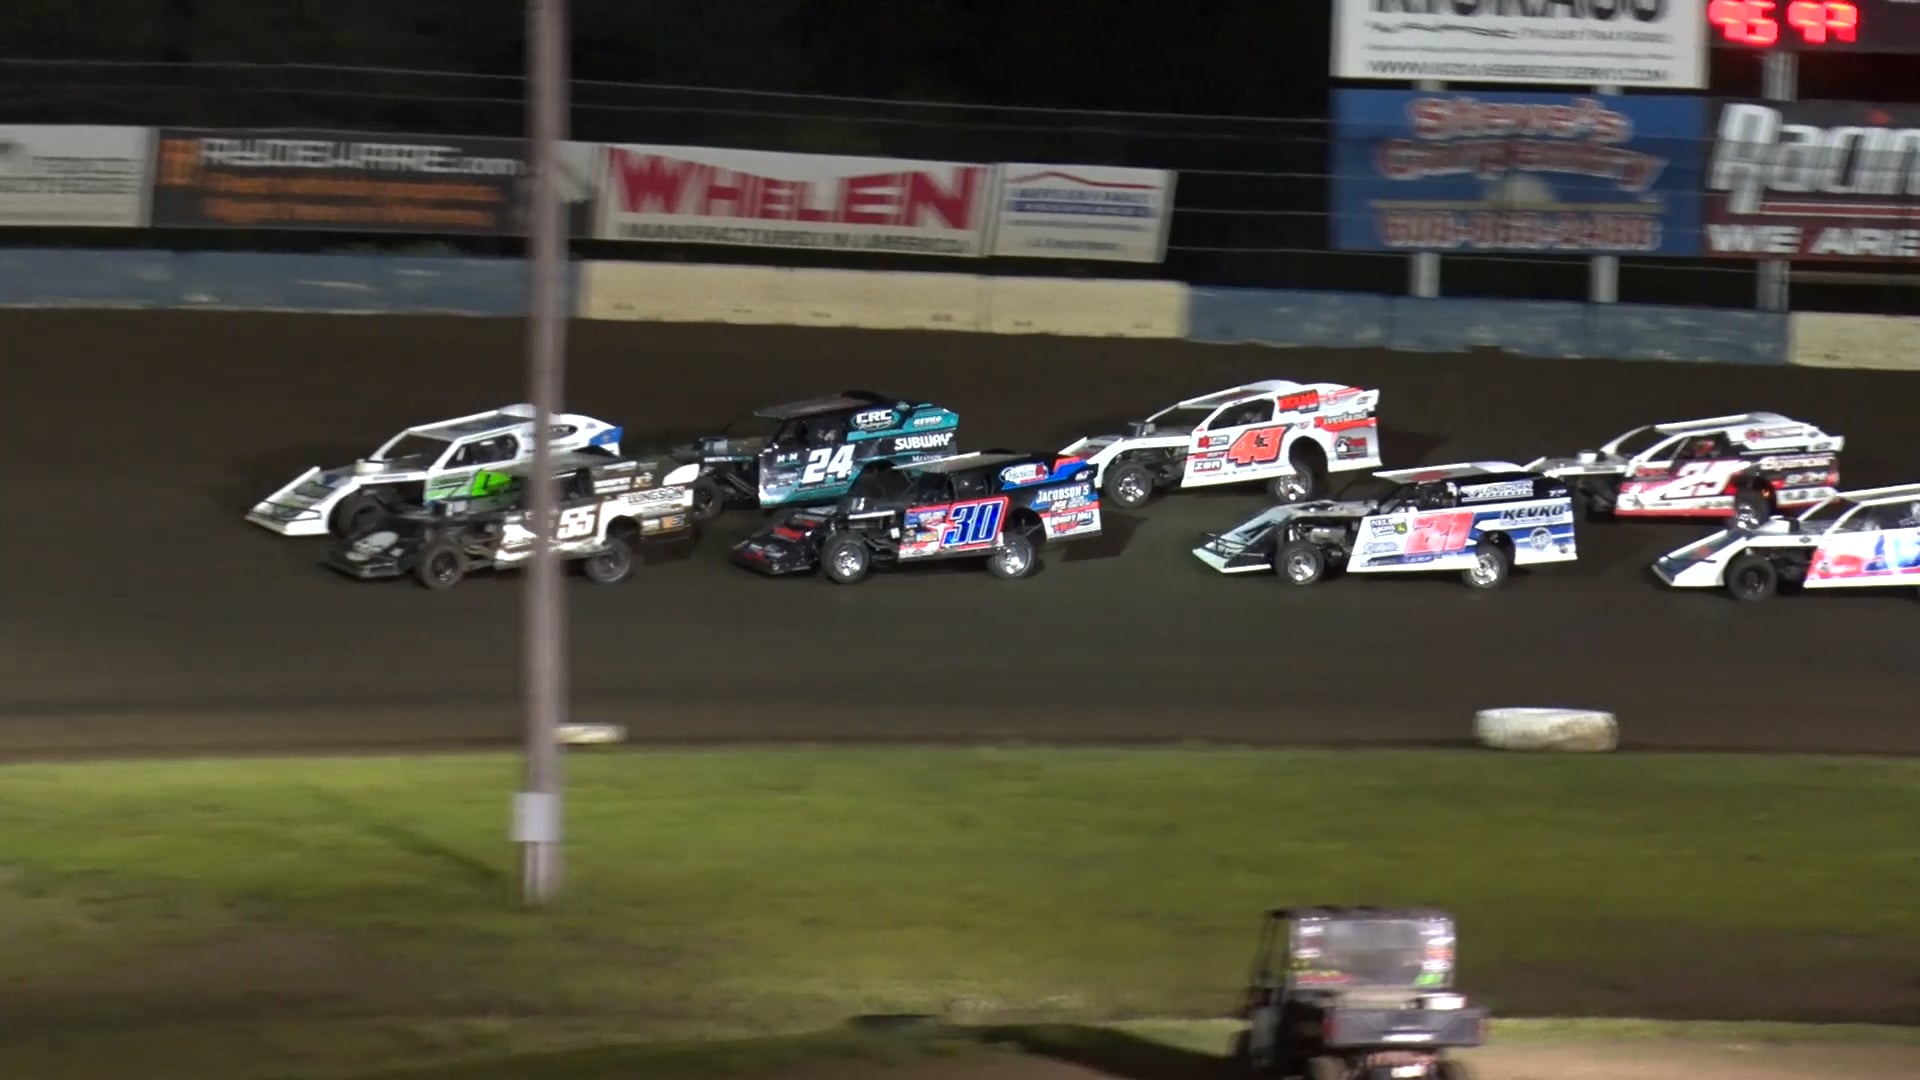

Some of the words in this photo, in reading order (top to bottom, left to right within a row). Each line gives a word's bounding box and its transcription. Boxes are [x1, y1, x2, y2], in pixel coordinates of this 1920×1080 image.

[608, 146, 984, 230] WHELEN
[1706, 224, 1801, 254] WE
[856, 409, 892, 424] CRC
[894, 432, 953, 451] SUBWAY
[1228, 425, 1288, 468] 43
[801, 444, 856, 484] 24
[556, 504, 597, 540] 55
[941, 500, 1004, 548] 30
[1502, 504, 1563, 520] KEVKO
[1405, 512, 1474, 555] 21
